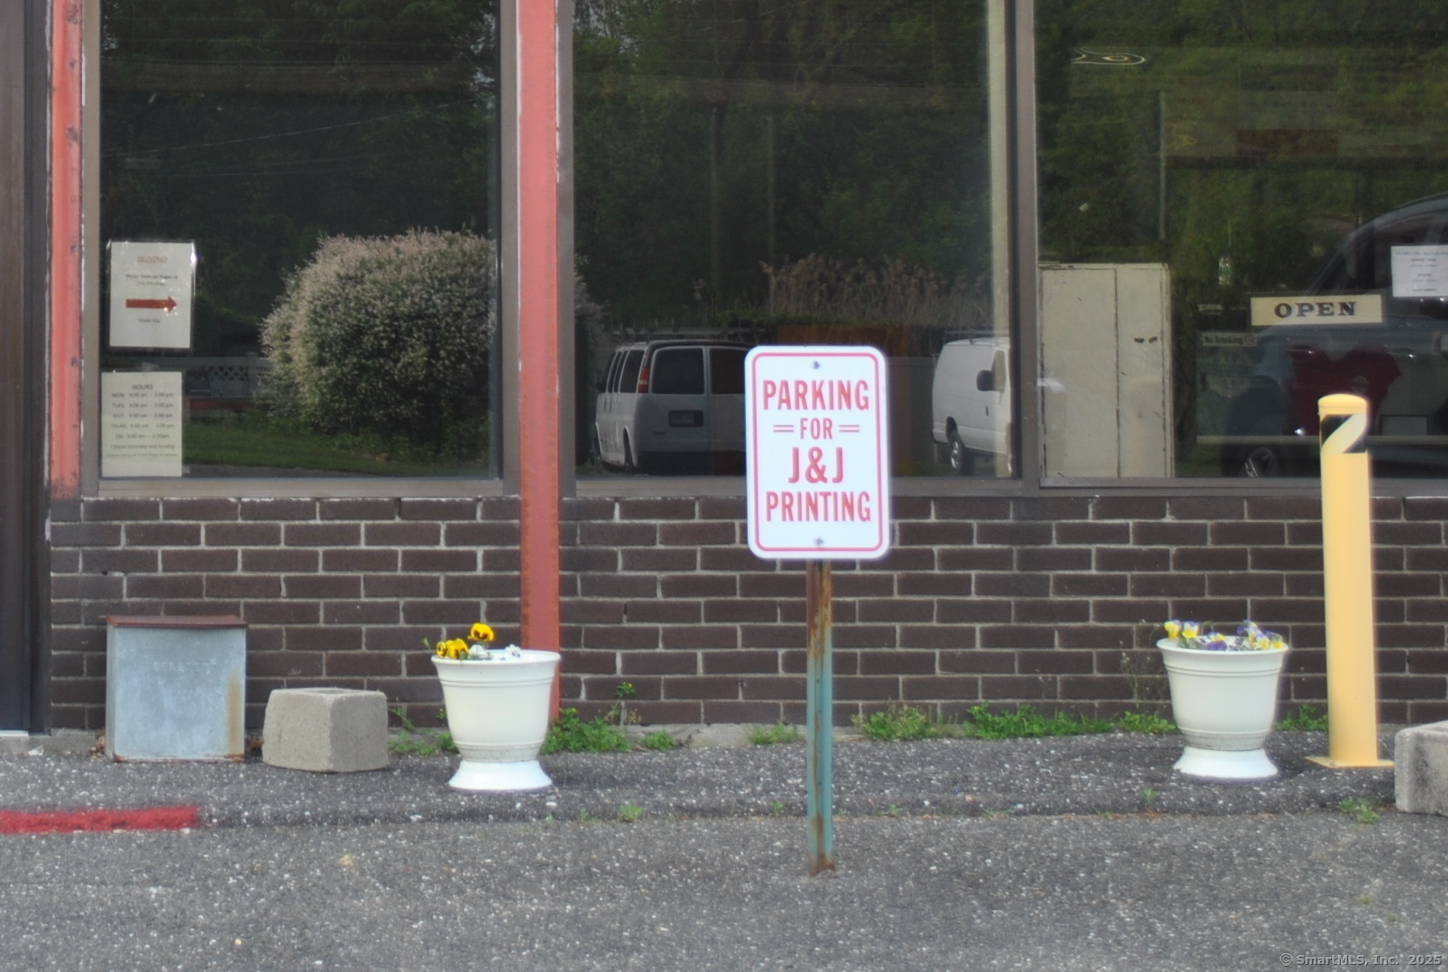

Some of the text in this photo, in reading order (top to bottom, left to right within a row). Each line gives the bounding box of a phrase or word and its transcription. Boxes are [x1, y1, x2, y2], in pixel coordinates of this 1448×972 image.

[1274, 301, 1357, 318] OPEN
[762, 380, 869, 411] PARKING
[800, 417, 833, 440] FOR
[788, 446, 844, 484] J&J
[766, 491, 871, 522] PRINTING
